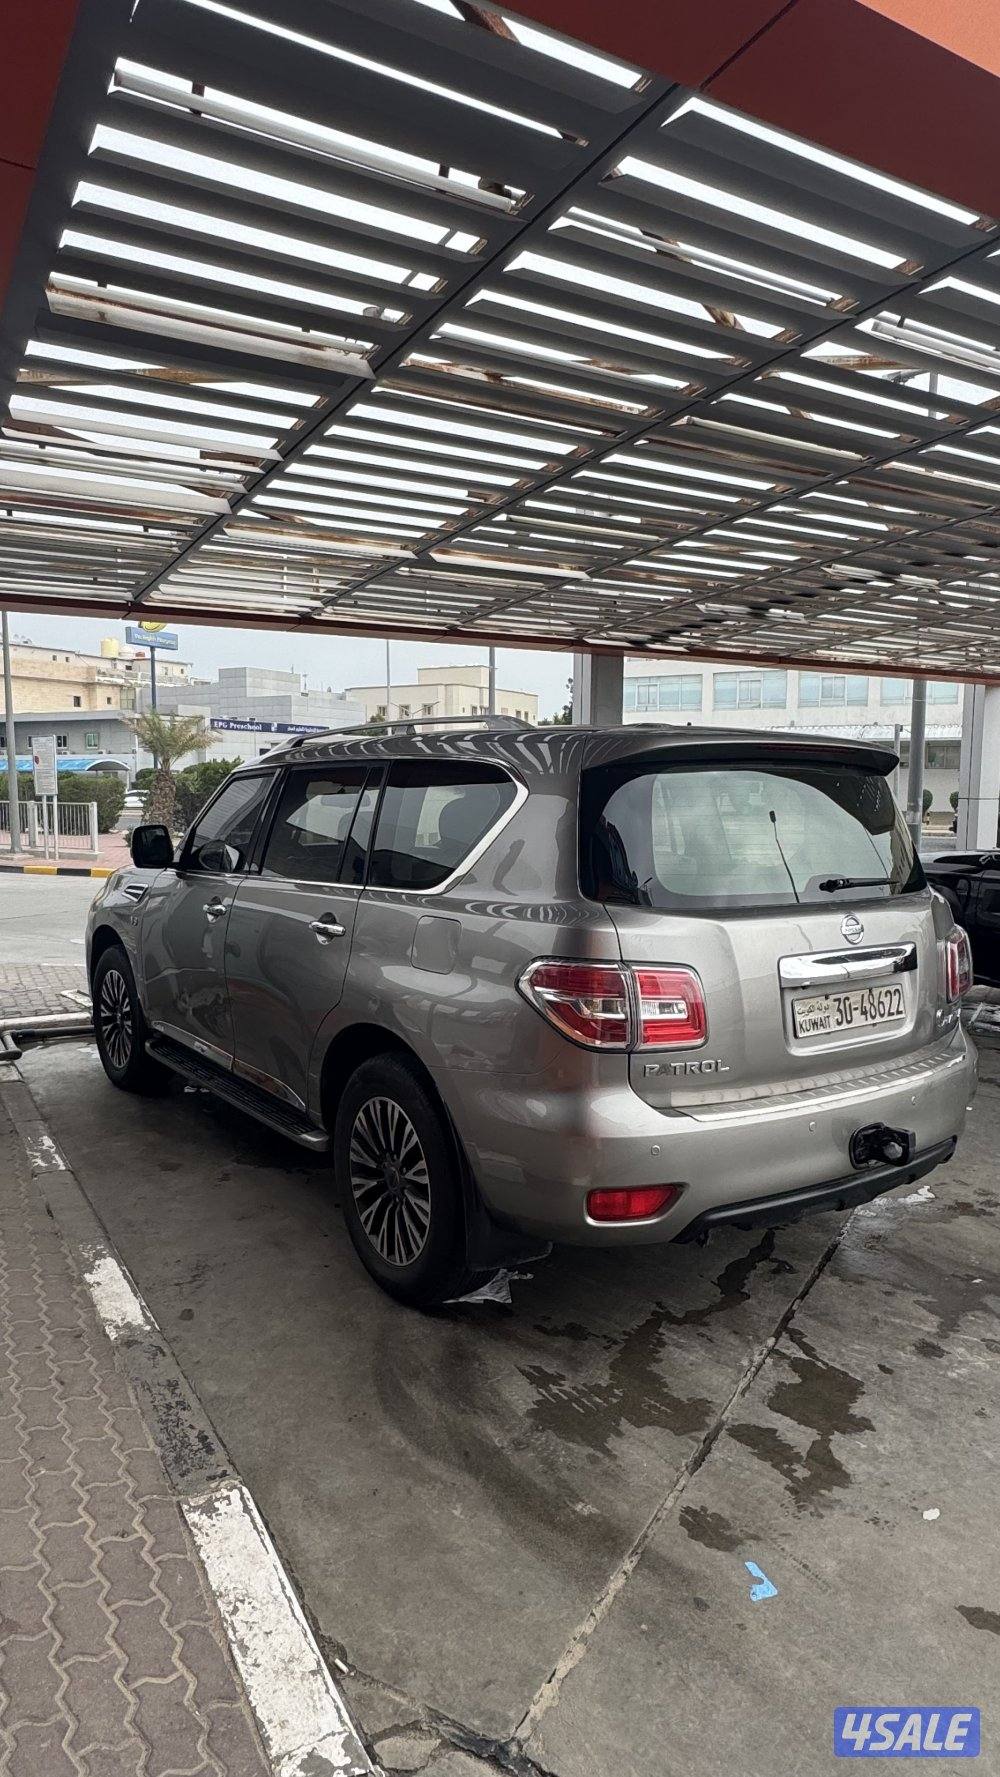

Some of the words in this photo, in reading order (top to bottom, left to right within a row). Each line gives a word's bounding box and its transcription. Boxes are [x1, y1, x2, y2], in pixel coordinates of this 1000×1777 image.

[214, 720, 228, 729] EPG
[229, 722, 262, 731] Preschool
[833, 988, 904, 1027] 30-48622
[798, 1015, 831, 1034] KUWAIT
[643, 1059, 730, 1078] PATROL
